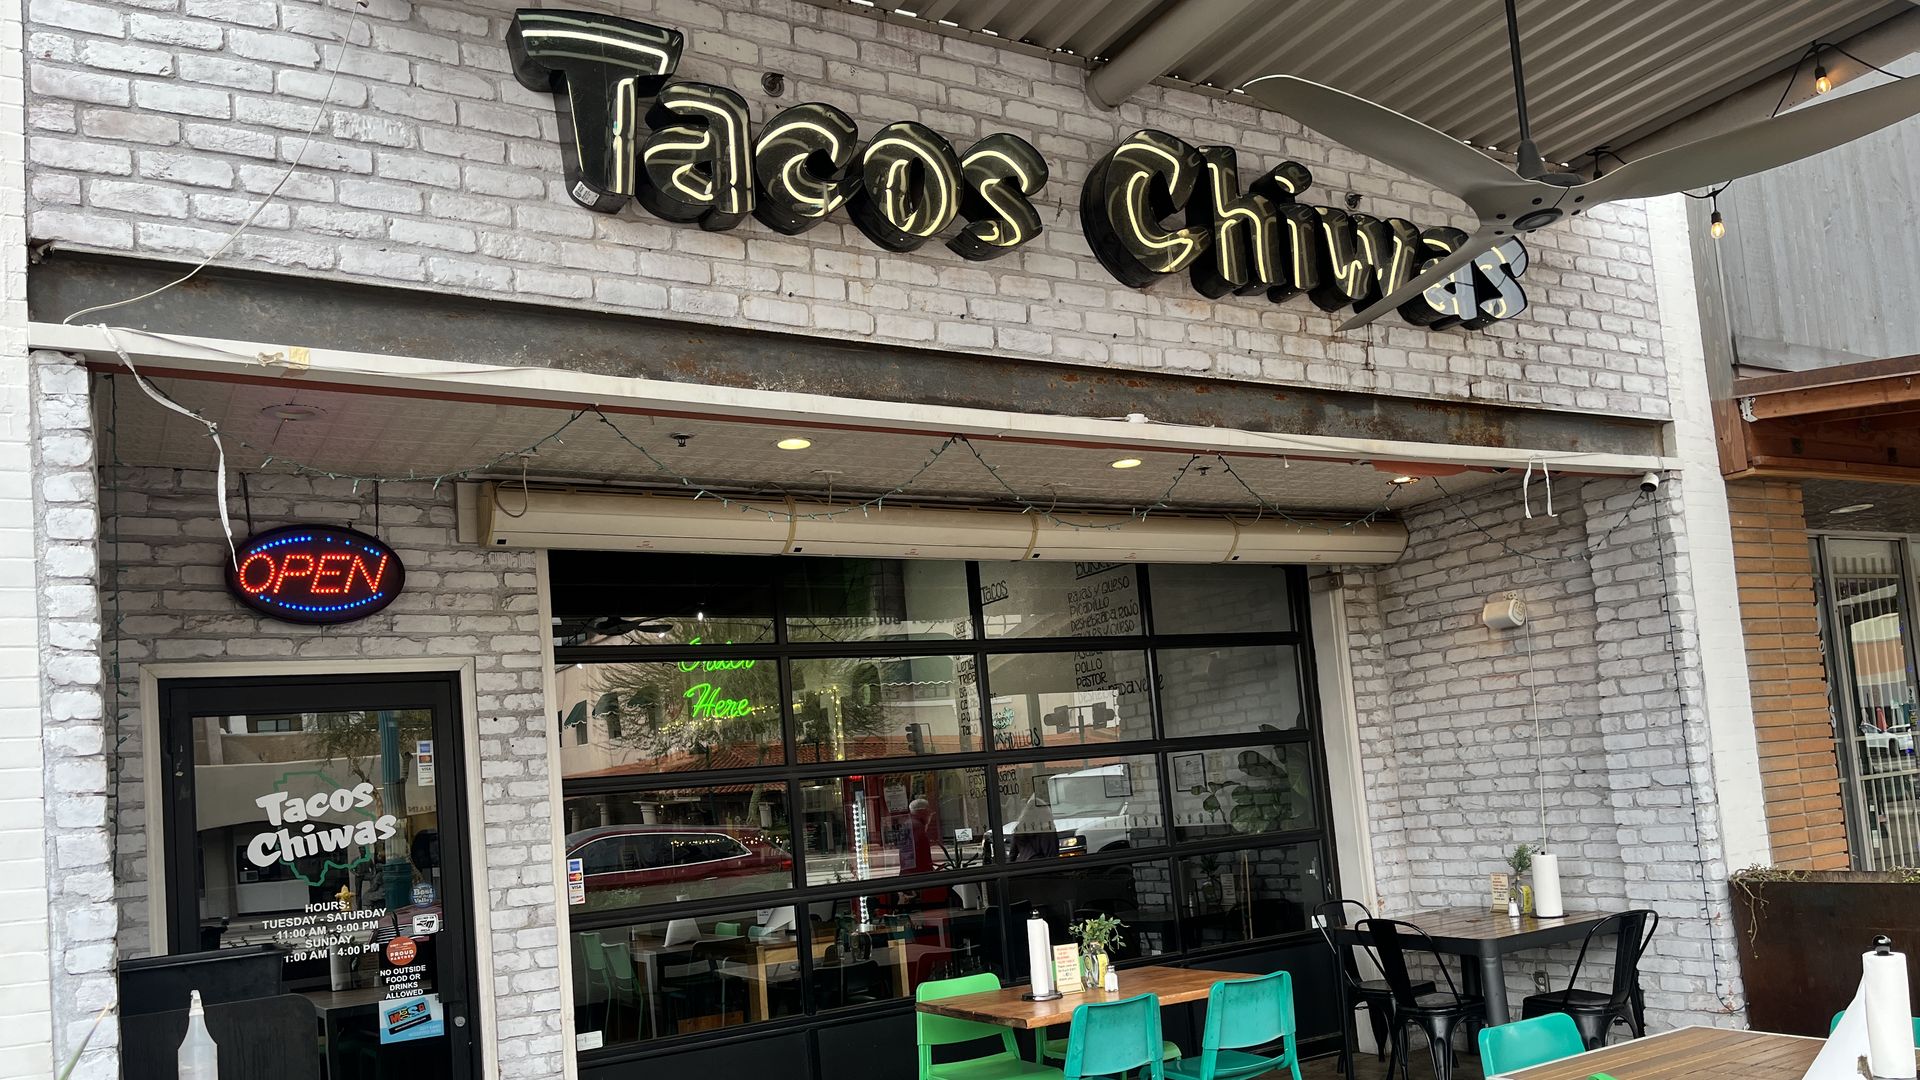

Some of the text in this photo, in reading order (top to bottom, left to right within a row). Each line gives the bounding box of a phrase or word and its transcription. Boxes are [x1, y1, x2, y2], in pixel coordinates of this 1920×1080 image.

[508, 8, 1529, 331] Tacos Chiwas
[239, 552, 389, 595] OPEN
[1075, 658, 1103, 675] POLLO
[683, 682, 752, 718] Here
[255, 782, 375, 826] Tacos
[247, 814, 397, 867] Chiwas
[305, 900, 350, 913] HOURS:
[262, 915, 317, 929] TUESDAY
[326, 908, 387, 922] SATURDAY
[277, 928, 306, 940] 11:00
[308, 926, 327, 937] AM
[336, 922, 359, 934] 9:00
[362, 920, 379, 931] PM
[305, 935, 353, 948] SUNDAY
[283, 951, 307, 963] 1:00
[309, 949, 328, 960] AM
[337, 945, 360, 957] 4:00
[363, 943, 380, 954] PM
[390, 949, 414, 958] PROUD
[380, 965, 426, 977] NO OUTSIDE
[386, 973, 421, 984] FOOD OR
[385, 988, 424, 1000] ALLOWED
[389, 981, 418, 991] DRINKS
